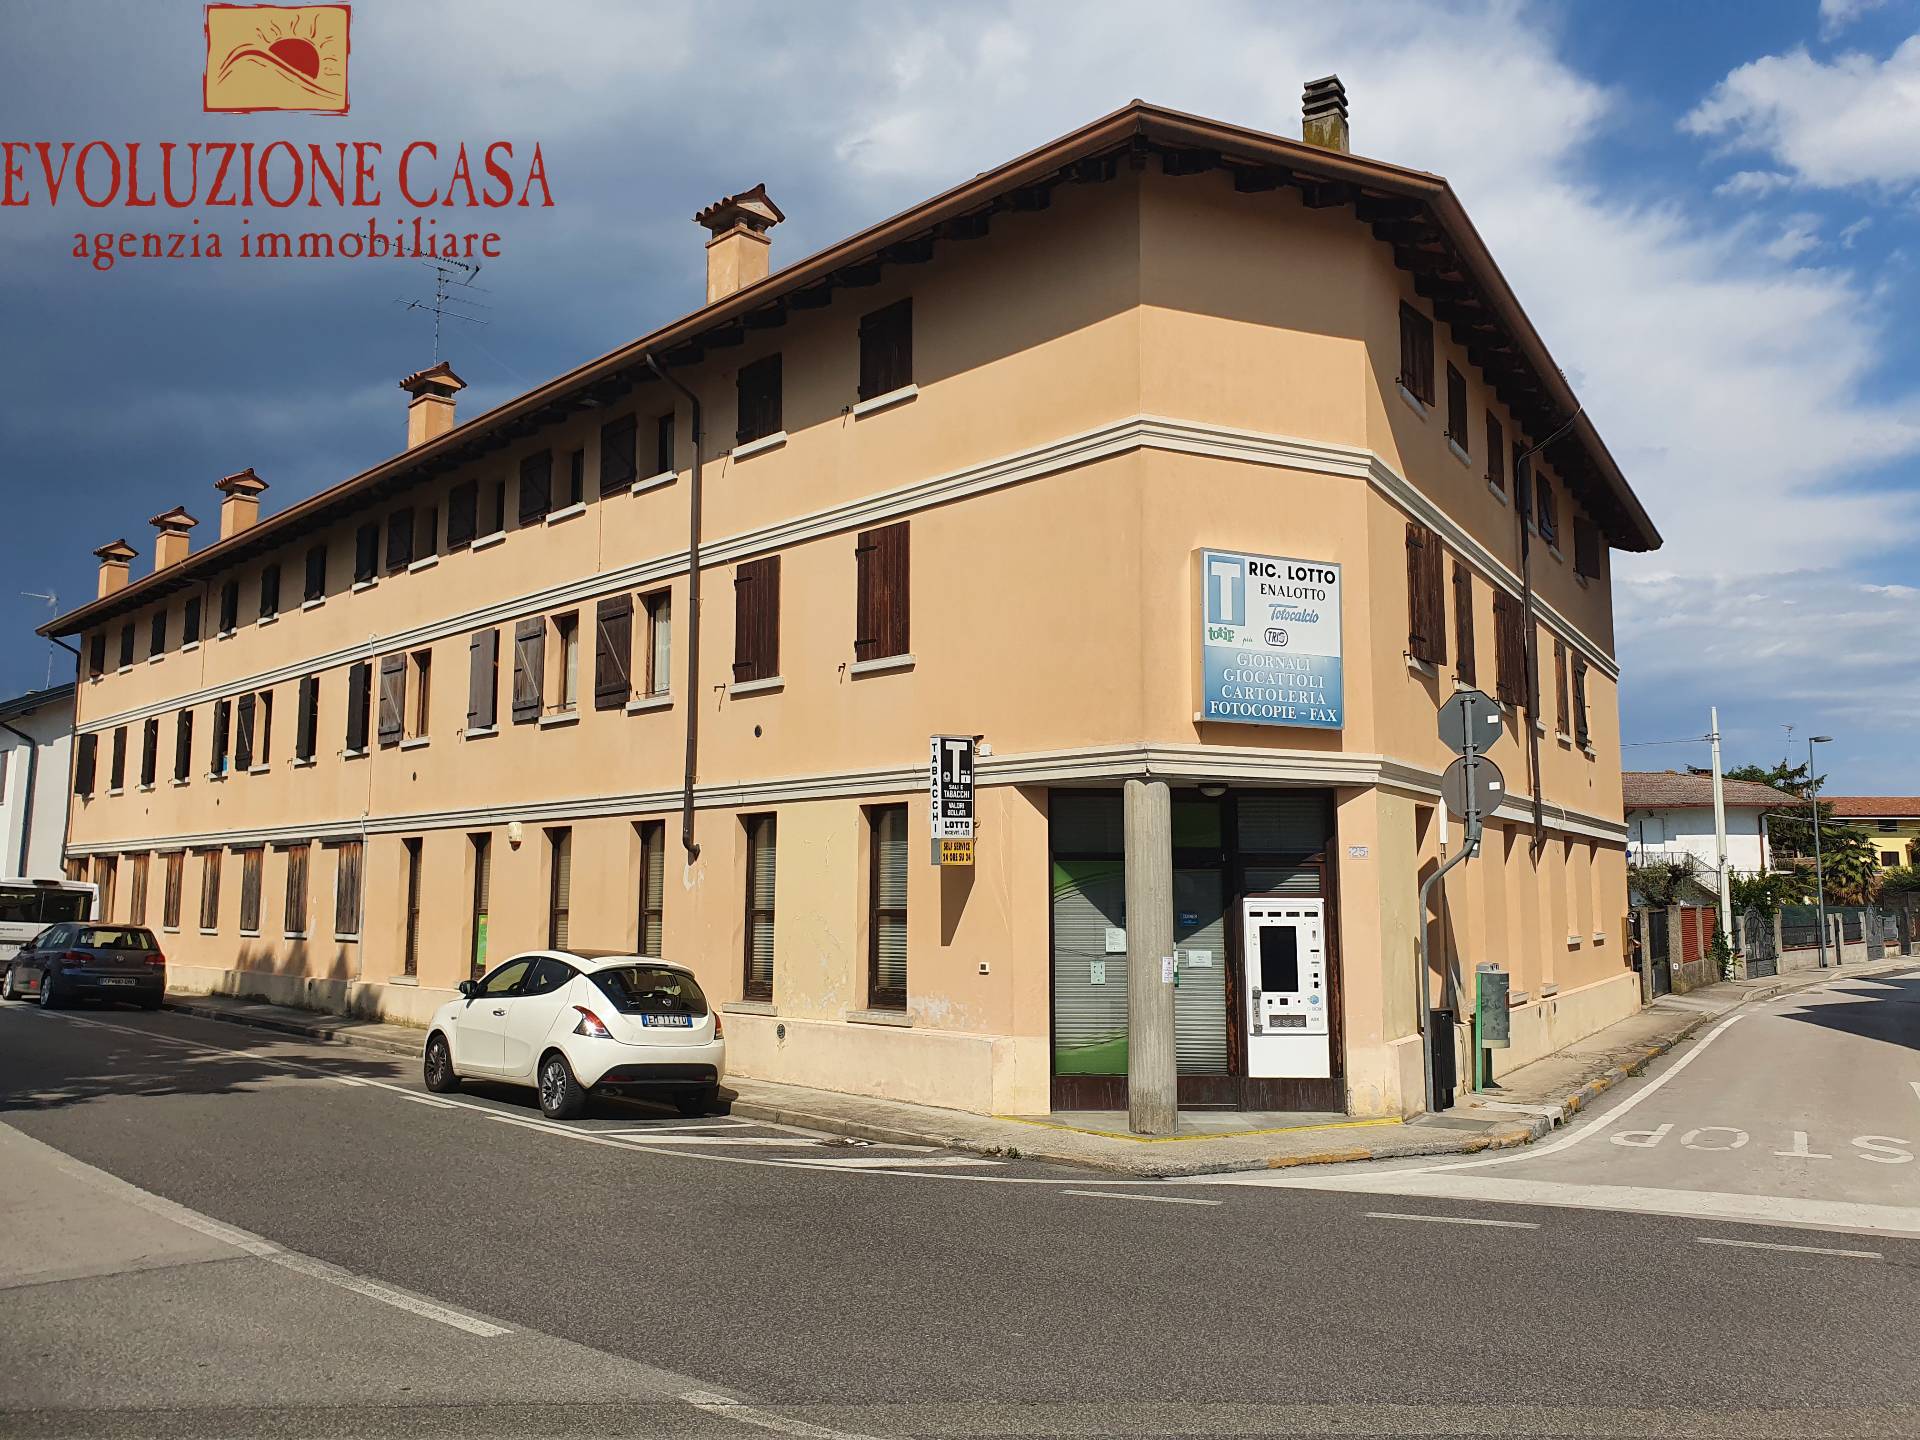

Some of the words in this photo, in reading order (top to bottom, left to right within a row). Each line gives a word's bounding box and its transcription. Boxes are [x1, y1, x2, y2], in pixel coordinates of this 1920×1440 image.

[1249, 561, 1281, 578] RIC.
[1287, 565, 1336, 584] LOTTO
[1210, 561, 1241, 621] T
[1260, 583, 1326, 601] ENALOTTO
[1268, 603, 1319, 624] Totocalcio
[1208, 626, 1235, 643] totip
[1236, 652, 1311, 671] GIORNALI
[1223, 668, 1324, 689] GIOCATTOLI
[1221, 684, 1326, 705] CARTOLERIA
[1209, 700, 1297, 720] FOTOCOPIE
[1310, 707, 1337, 722] FAX
[945, 740, 968, 784] T
[931, 743, 939, 833] TABACCHI
[944, 790, 970, 799] TABACCHI
[944, 821, 970, 829] LOTTO
[953, 841, 971, 851] SERVICE
[1609, 1123, 1914, 1164] STOP
